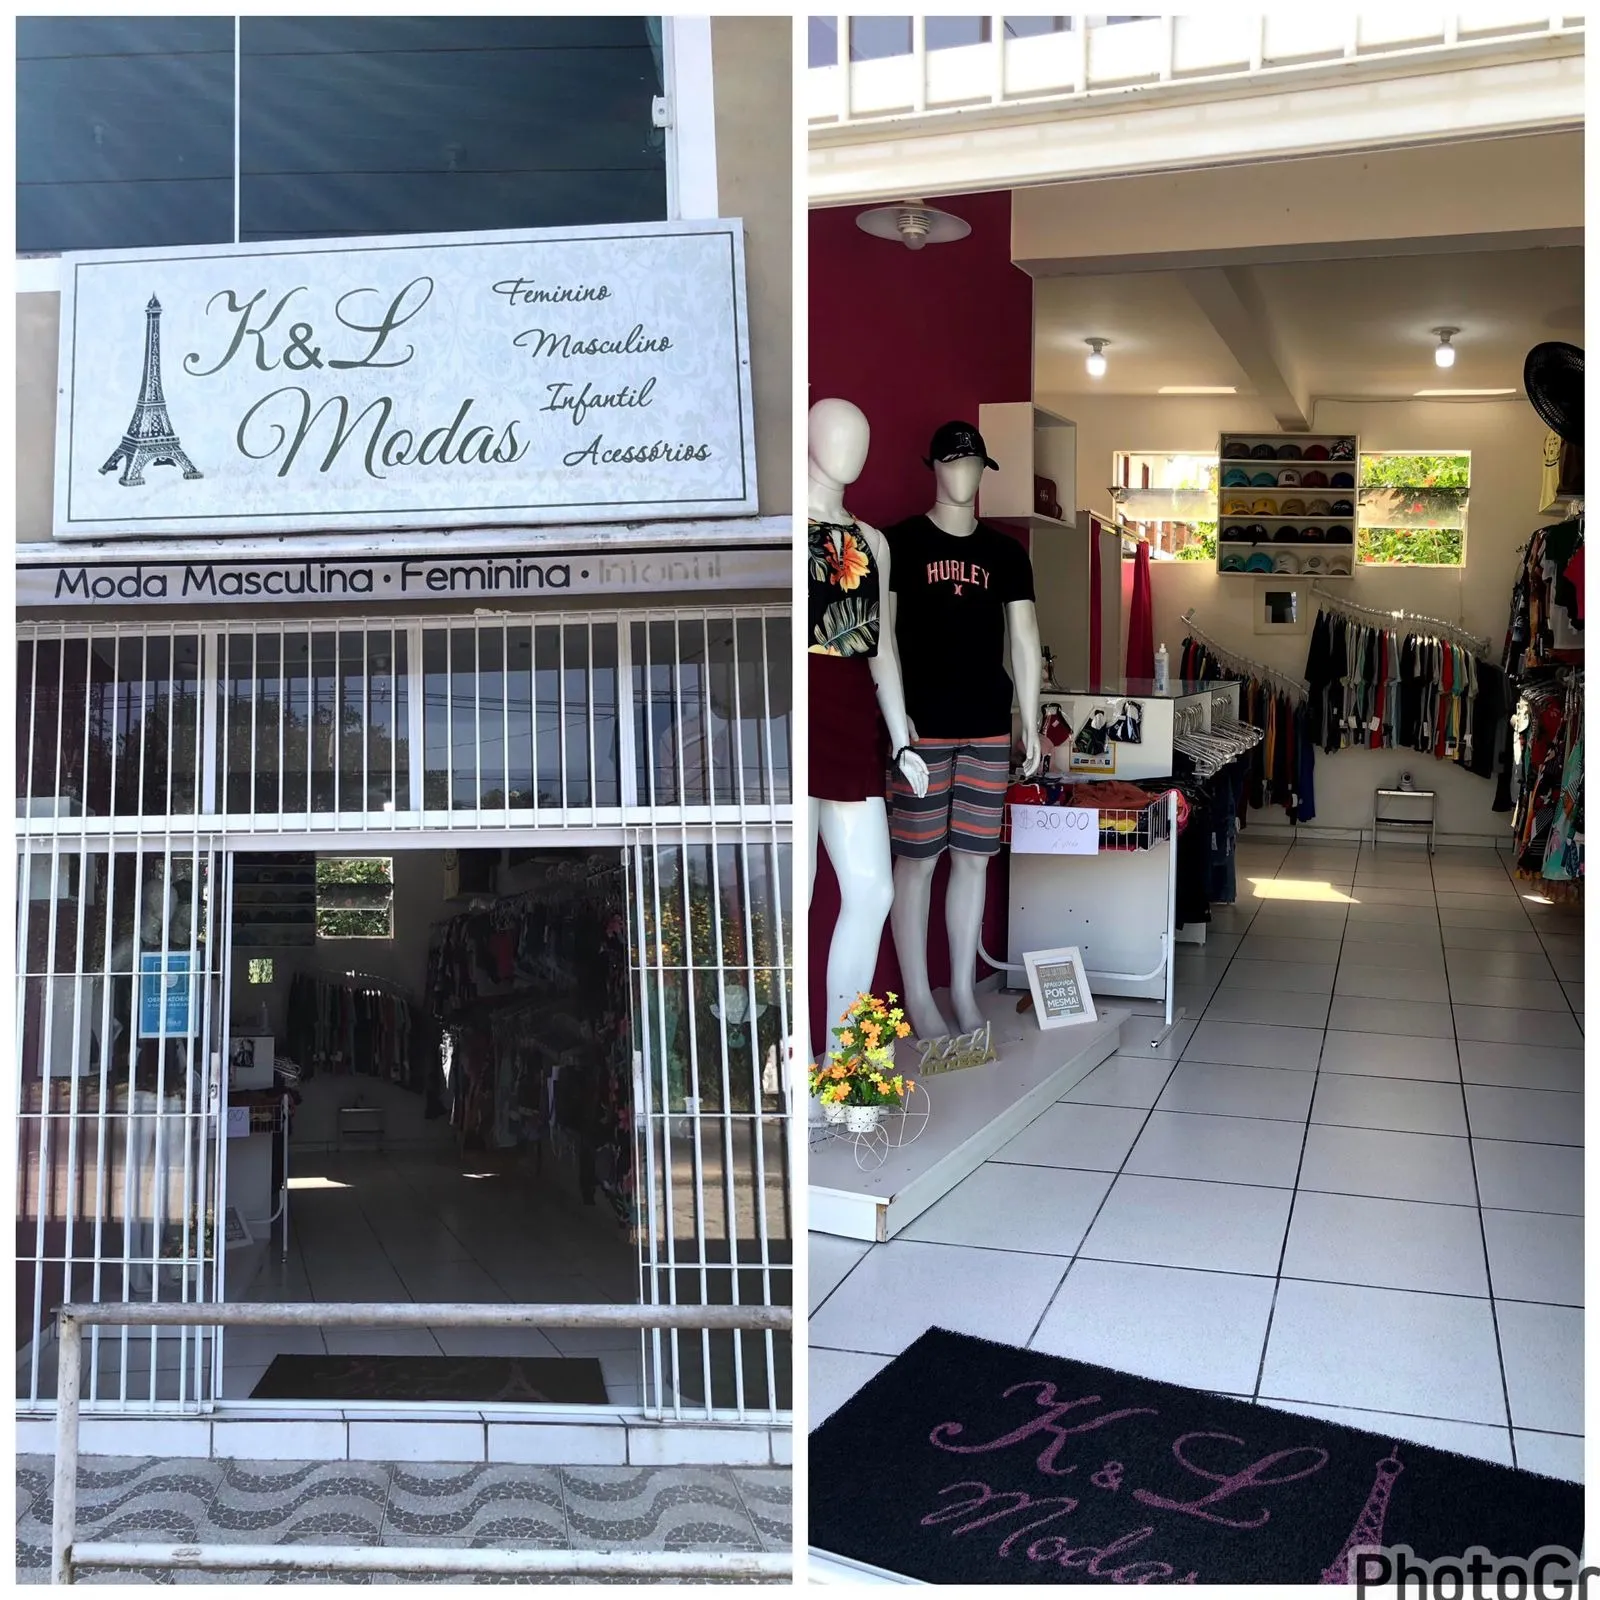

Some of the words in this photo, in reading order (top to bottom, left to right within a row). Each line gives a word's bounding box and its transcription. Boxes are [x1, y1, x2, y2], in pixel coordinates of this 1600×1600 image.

[492, 277, 612, 306] Feminino
[513, 323, 674, 358] Masculino
[539, 376, 657, 426] Infantil
[236, 386, 531, 479] Modas
[562, 434, 712, 467] Acessórios
[54, 566, 168, 599] Moda
[181, 563, 374, 596] Masculina
[401, 558, 571, 592] Feminina
[926, 559, 990, 590] HURLEY
[1044, 987, 1067, 999] POR
[1068, 985, 1077, 996] SI
[1047, 997, 1080, 1008] MESMA!
[920, 1481, 1200, 1584] Moda
